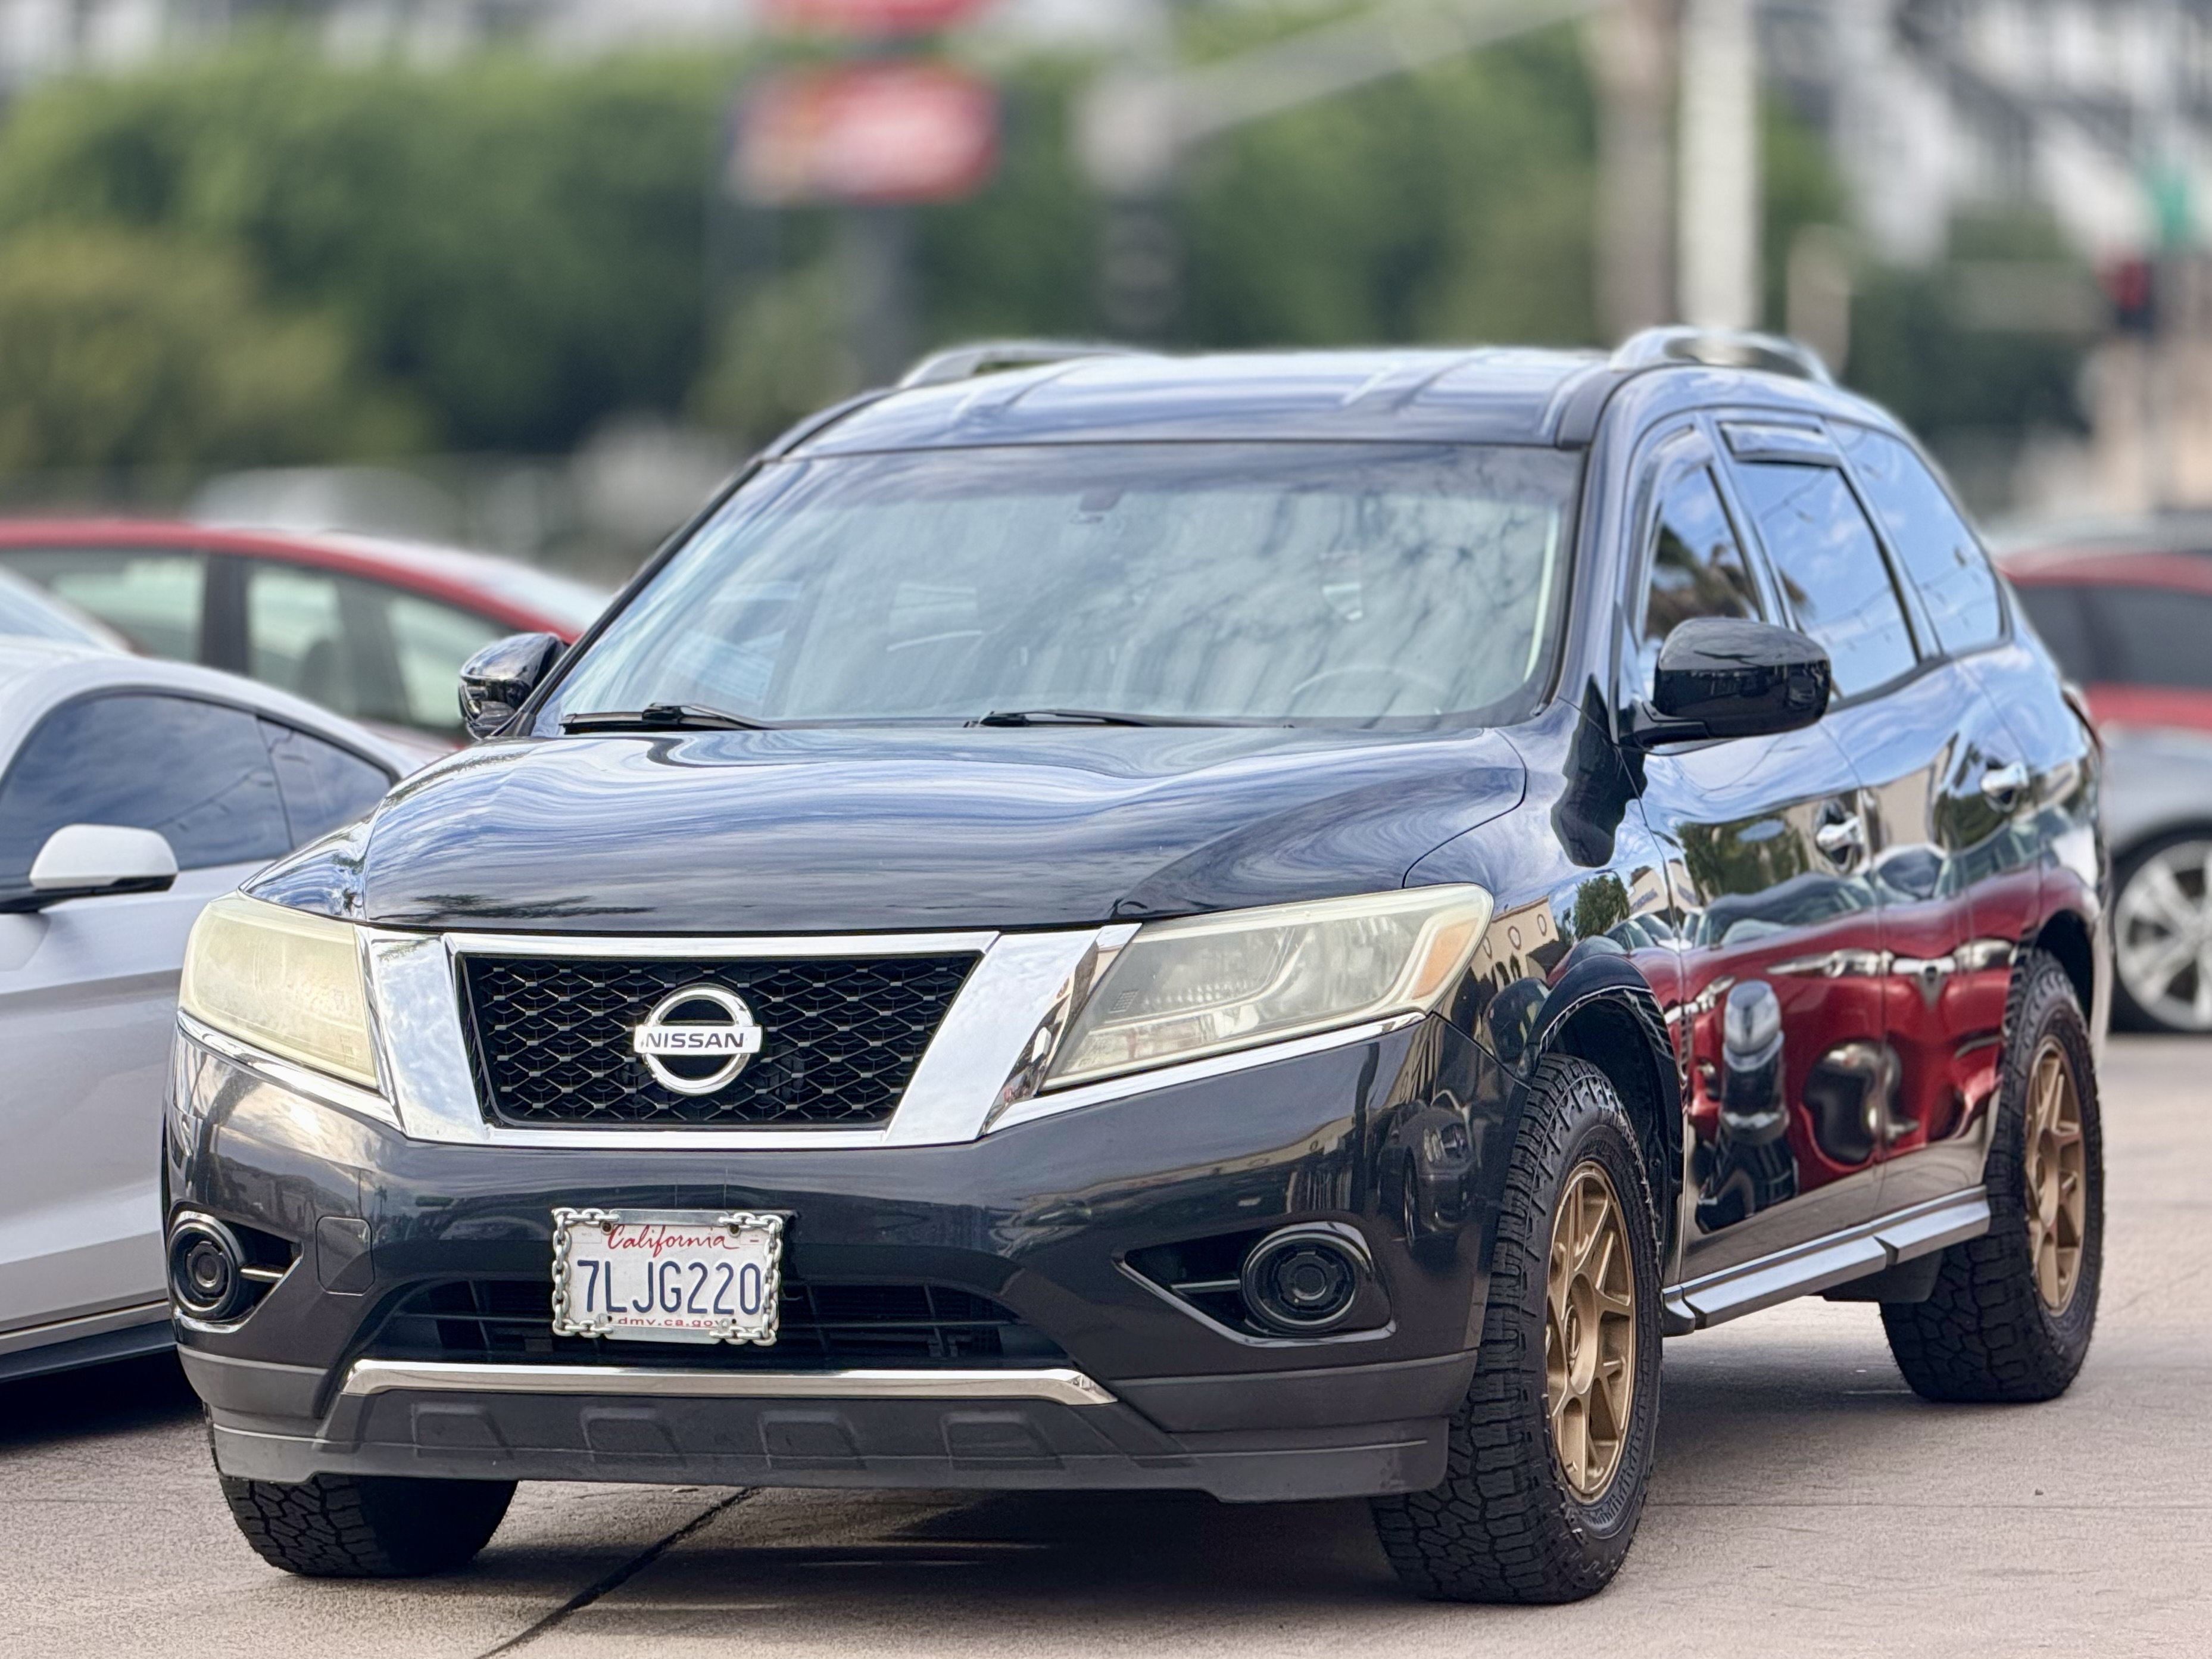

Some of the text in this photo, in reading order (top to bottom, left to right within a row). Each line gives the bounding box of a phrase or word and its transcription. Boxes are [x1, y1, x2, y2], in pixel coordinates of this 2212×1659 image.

[645, 1033, 744, 1048] NISSAN
[607, 1224, 740, 1258] California
[577, 1259, 760, 1315] 7LJG220
